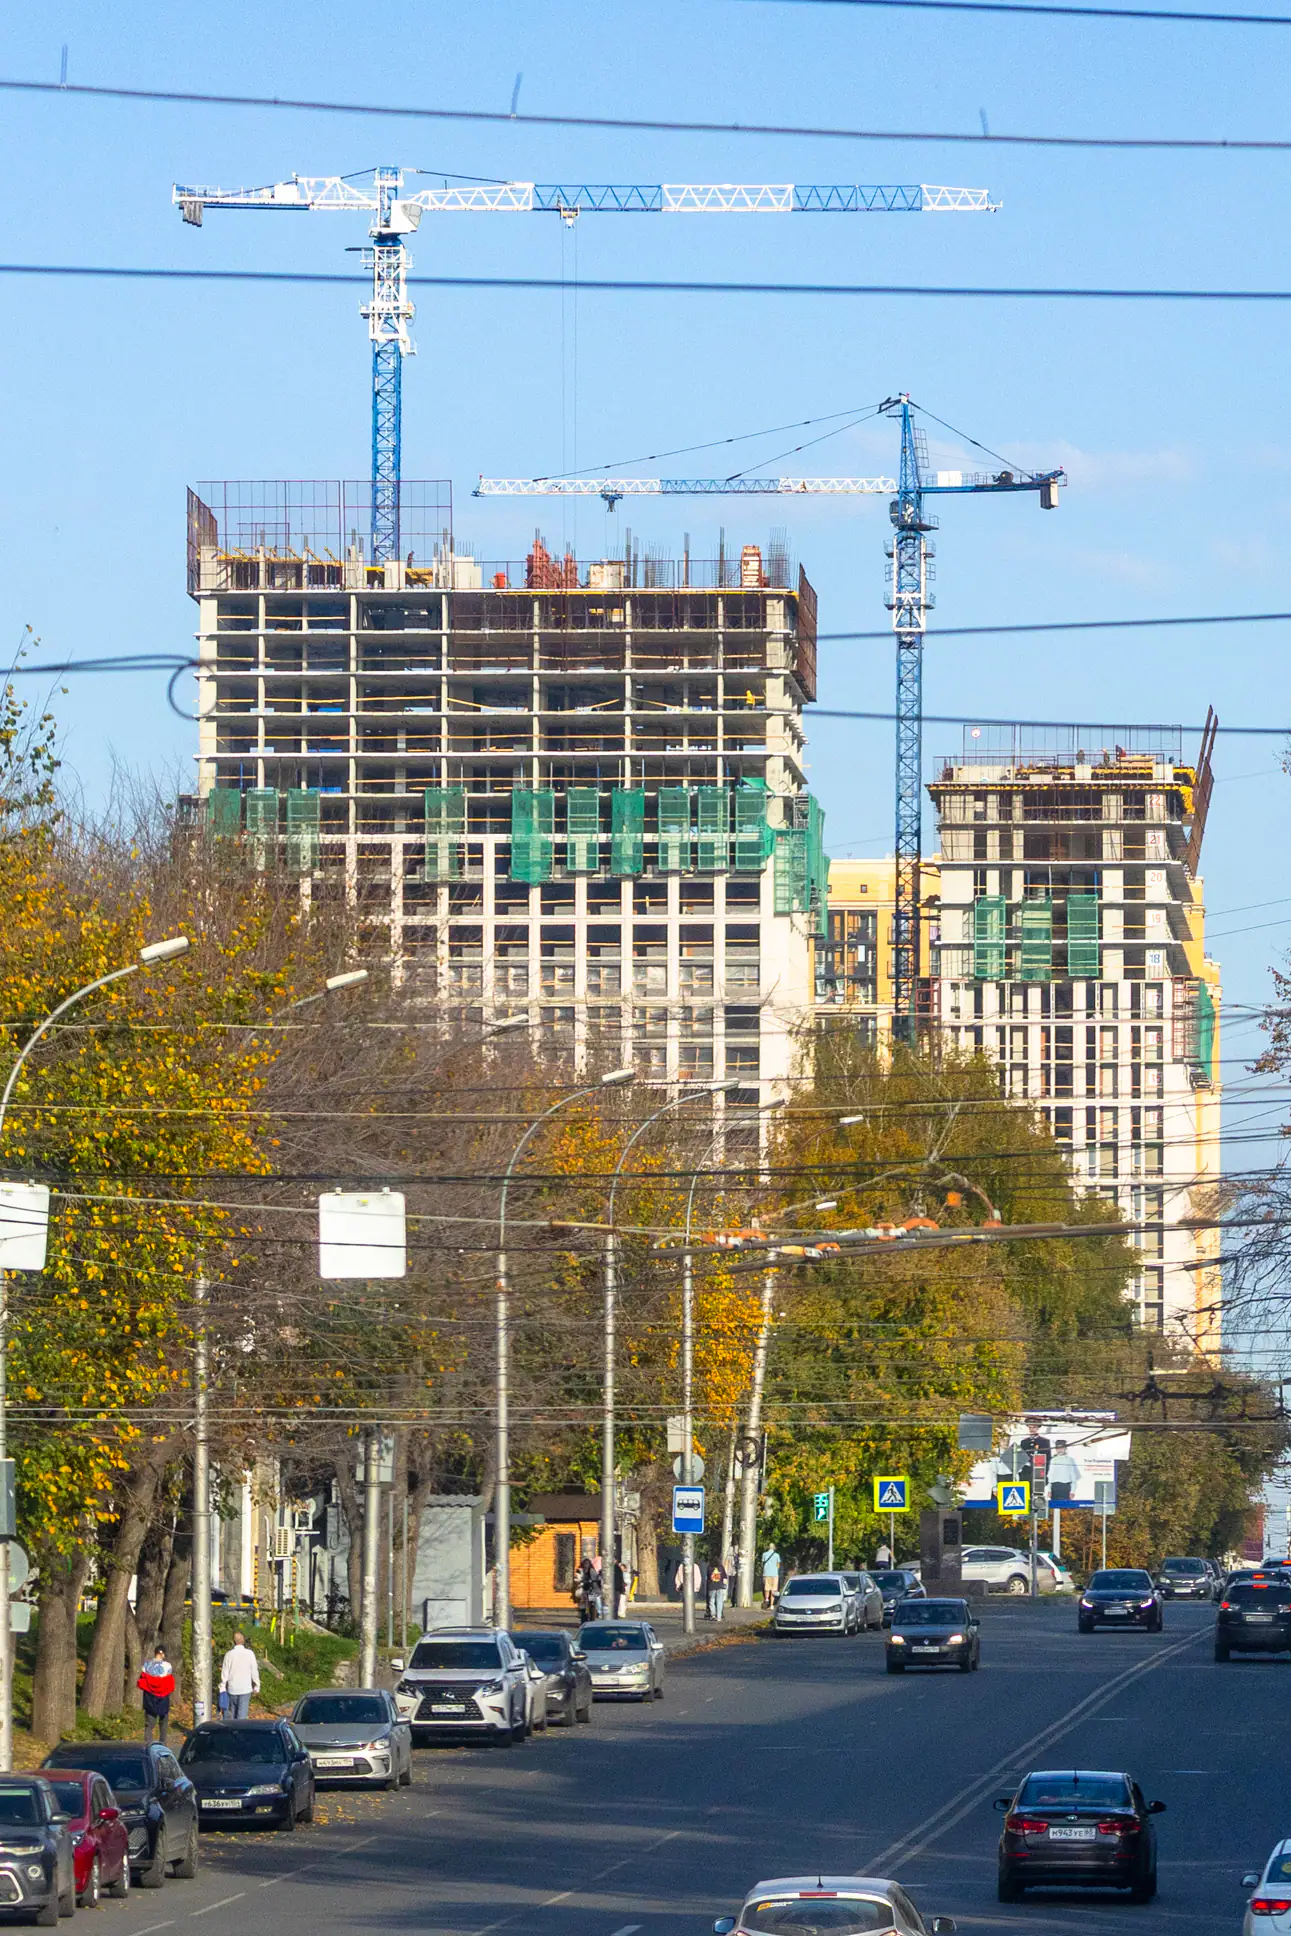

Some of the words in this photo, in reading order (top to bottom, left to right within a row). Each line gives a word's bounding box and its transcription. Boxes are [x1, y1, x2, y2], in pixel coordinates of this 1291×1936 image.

[1149, 794, 1160, 806] 22
[1149, 834, 1160, 845] 21
[1150, 872, 1162, 882] 20
[1151, 913, 1161, 924] 19
[1149, 954, 1160, 964] 18
